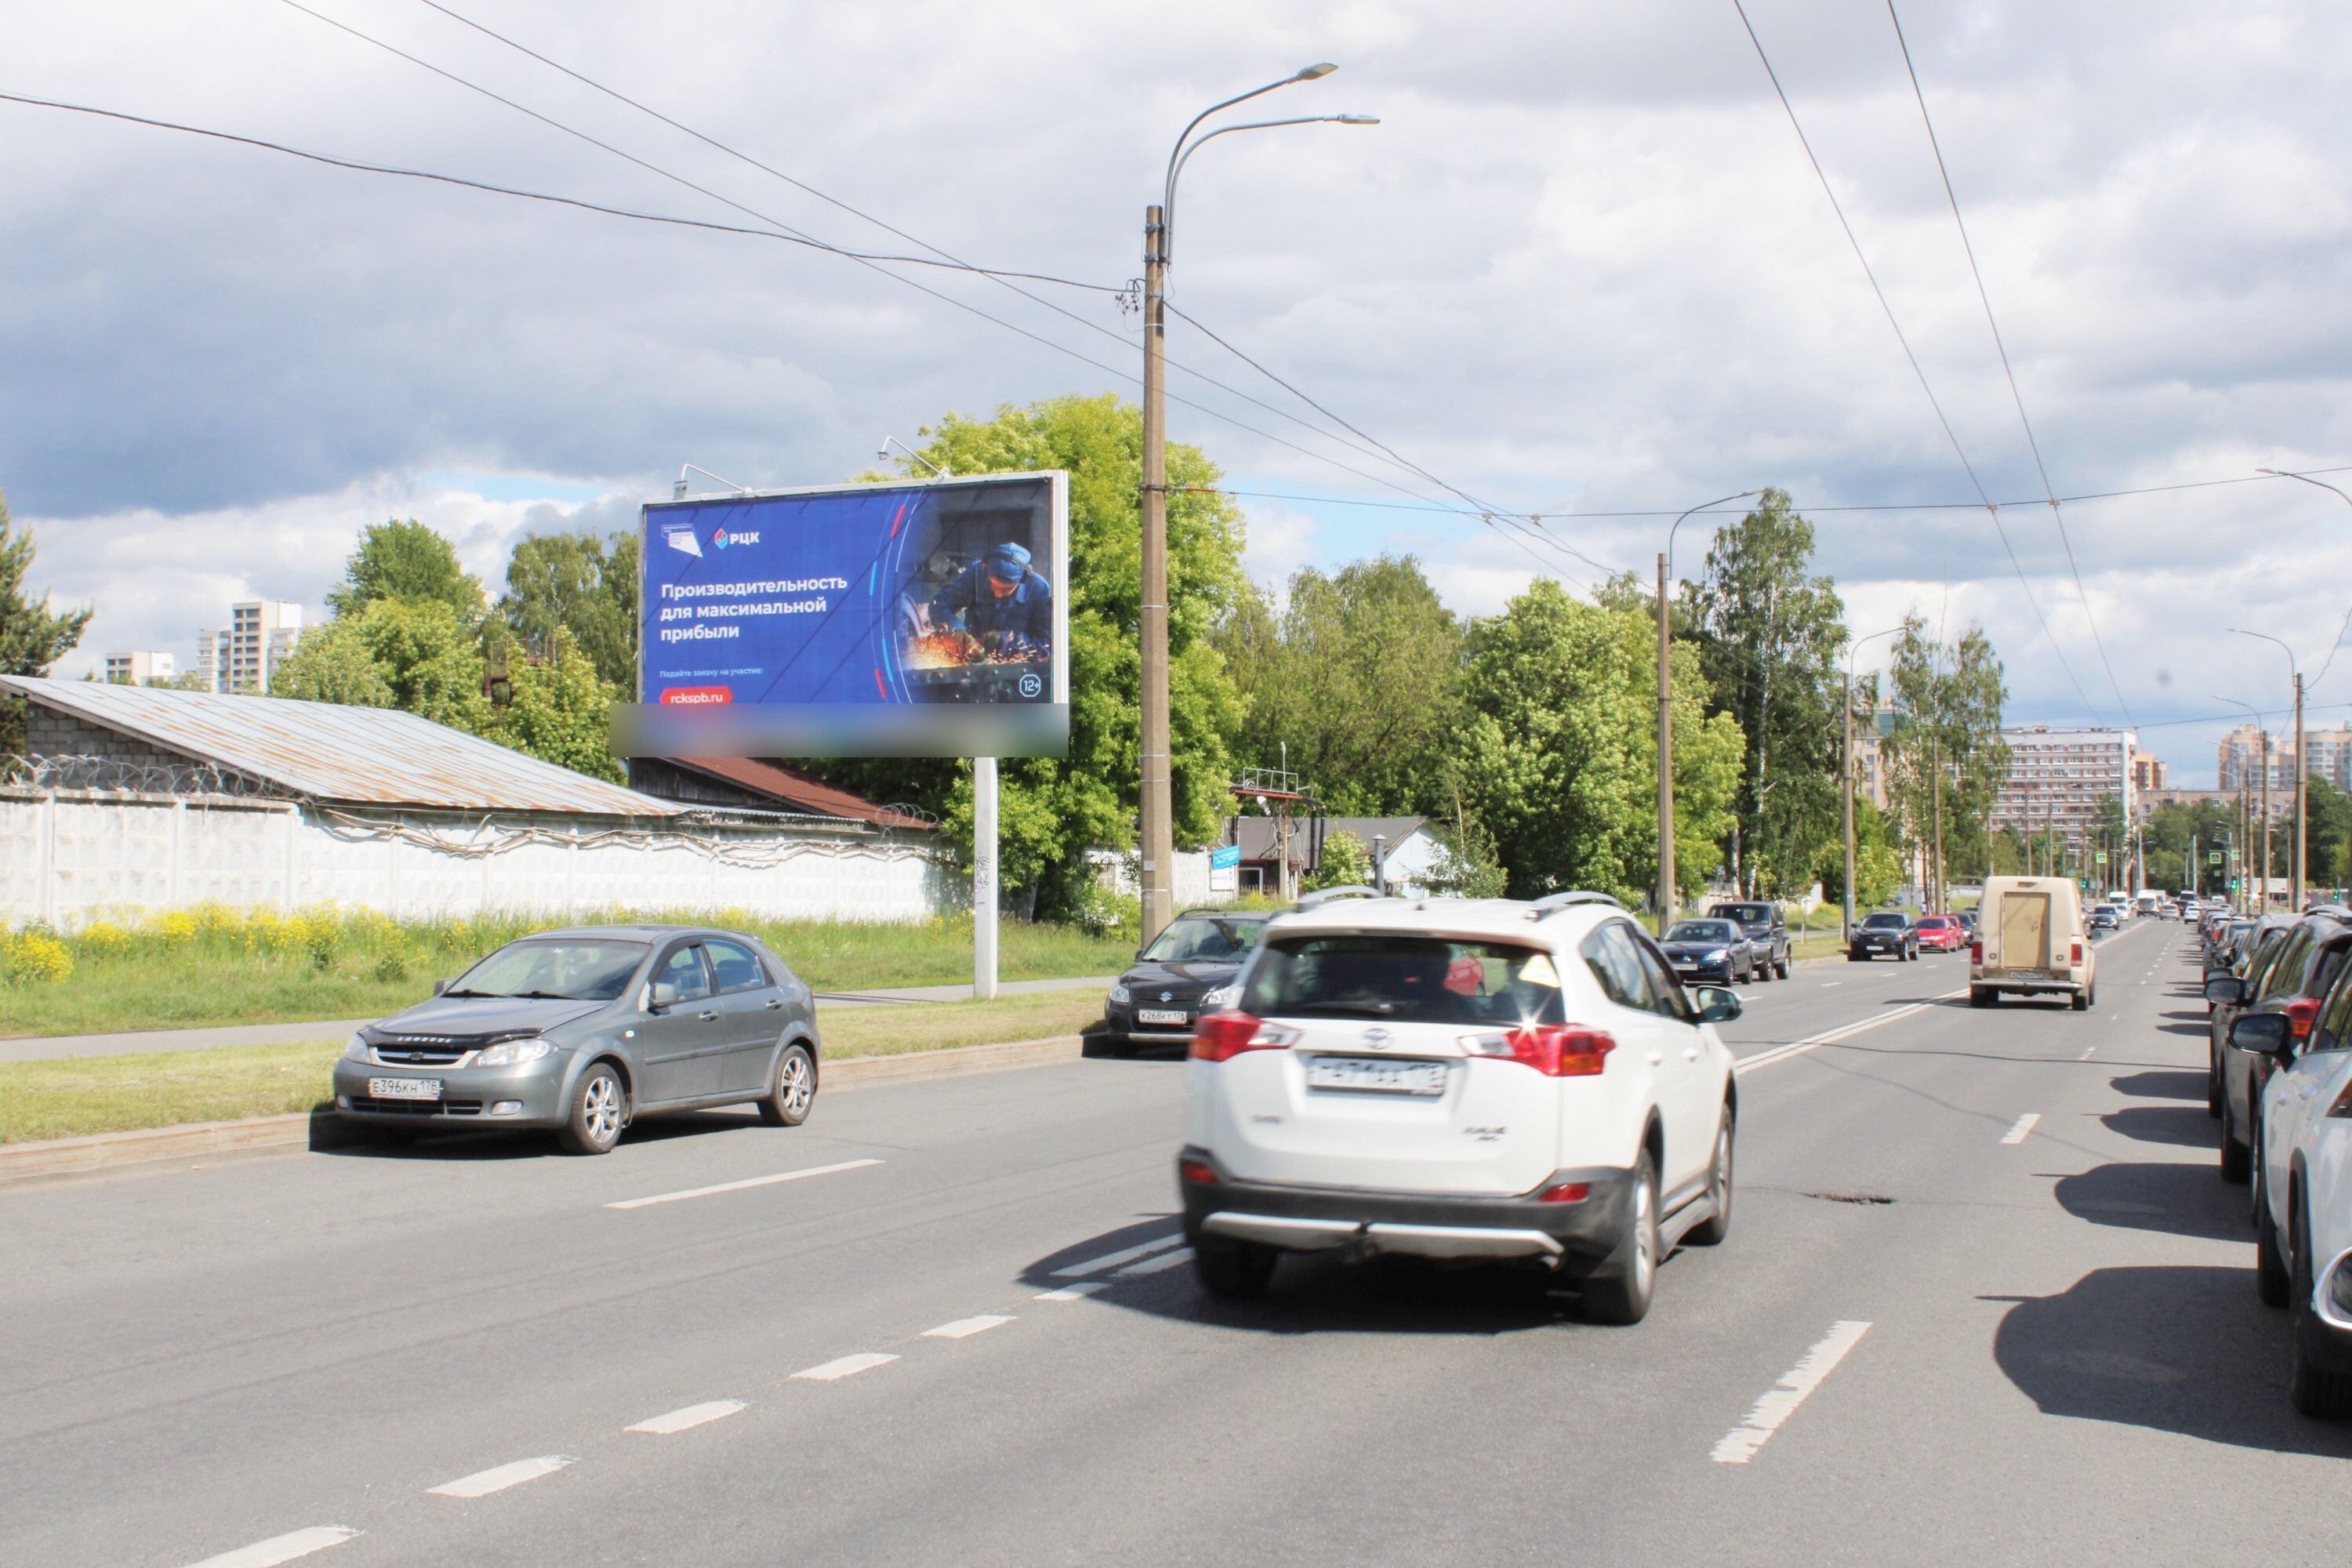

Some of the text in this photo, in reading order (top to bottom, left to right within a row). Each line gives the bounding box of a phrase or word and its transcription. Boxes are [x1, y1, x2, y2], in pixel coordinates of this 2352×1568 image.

[729, 532, 760, 546] РЦК
[661, 577, 848, 601] Производительность
[660, 597, 826, 621] для максимальной
[661, 624, 739, 643] прибыли
[659, 670, 691, 678] Подайте
[1024, 680, 1040, 691] 12+
[670, 692, 723, 704] rckspb.ru
[373, 1080, 437, 1094] Е396КН 178
